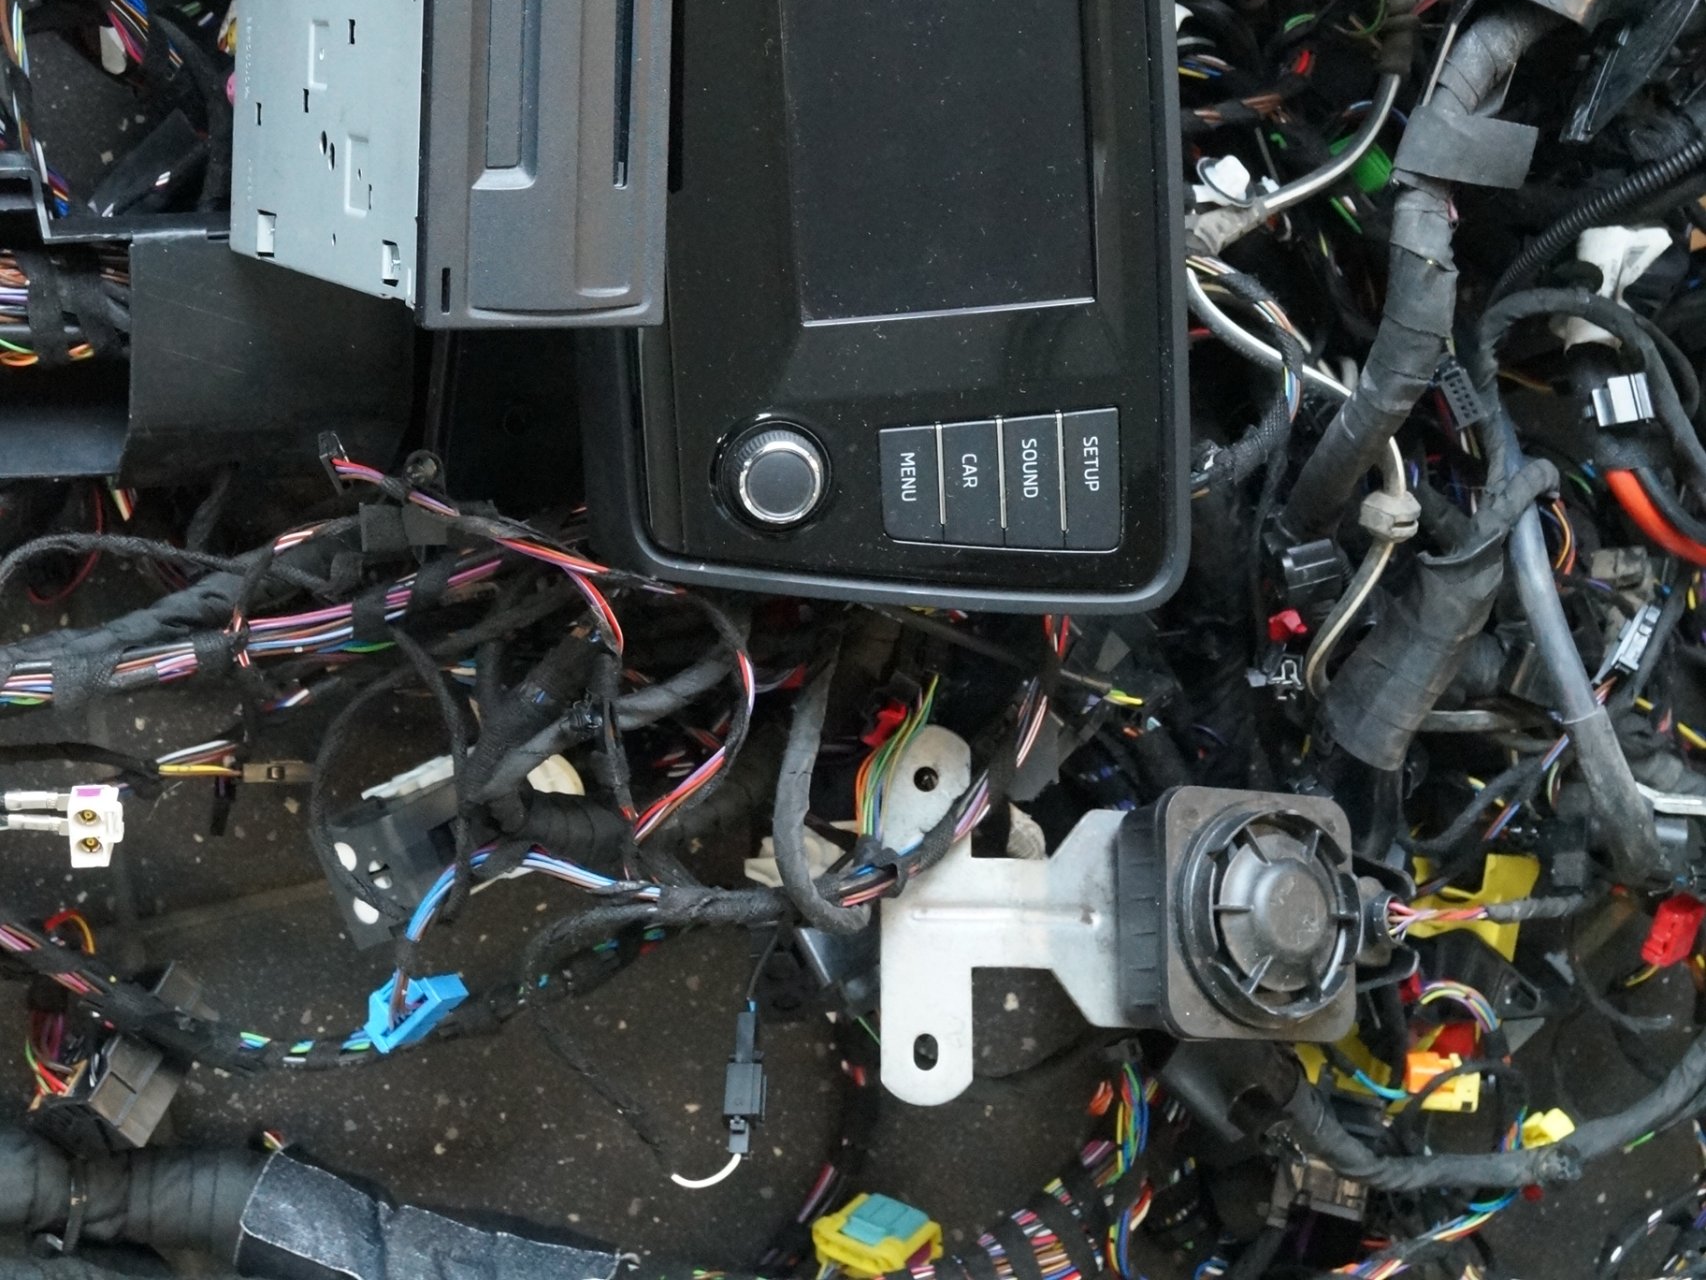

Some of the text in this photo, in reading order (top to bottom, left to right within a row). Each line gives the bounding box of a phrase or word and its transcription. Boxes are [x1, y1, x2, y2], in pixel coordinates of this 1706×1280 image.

[900, 452, 917, 502] MENU
[961, 453, 978, 489] CAR
[1021, 438, 1039, 499] SOUND
[1082, 436, 1100, 492] SETUP
